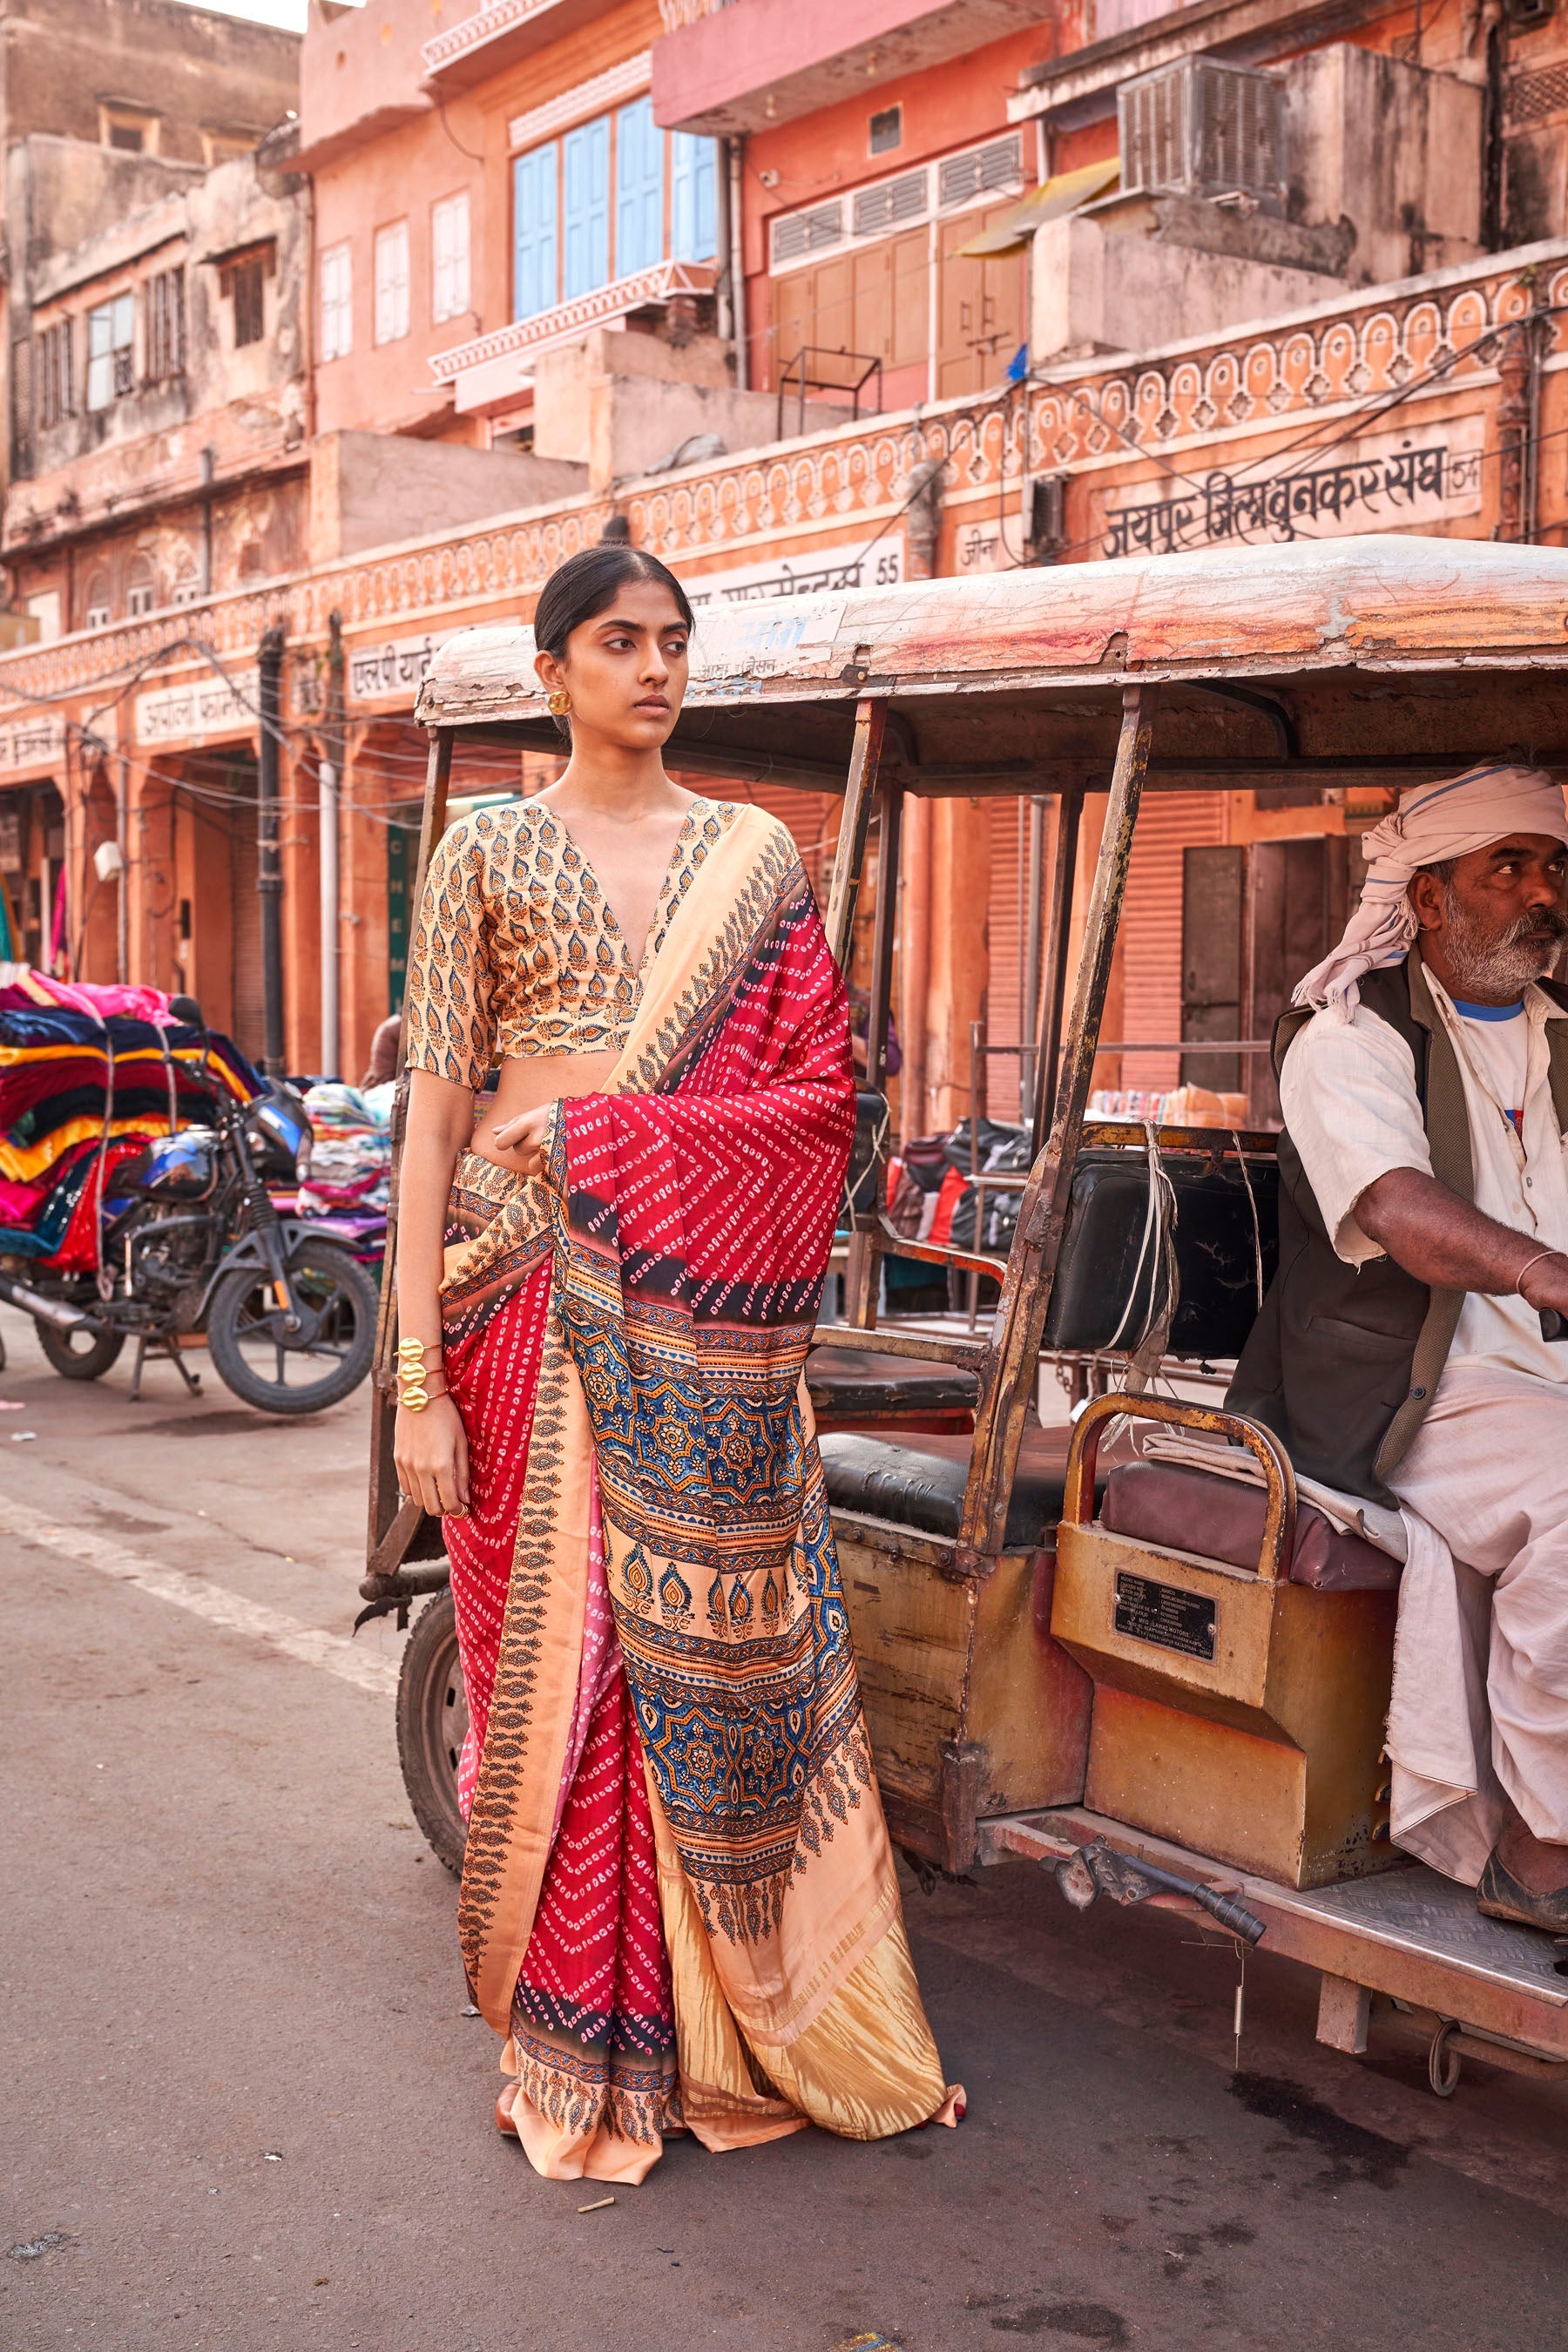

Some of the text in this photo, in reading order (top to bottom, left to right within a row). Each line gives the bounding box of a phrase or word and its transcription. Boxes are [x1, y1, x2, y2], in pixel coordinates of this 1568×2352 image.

[1102, 495, 1199, 559] जयपुर
[1385, 439, 1448, 506] संघ
[1451, 454, 1479, 490] 54
[875, 554, 899, 585] 55
